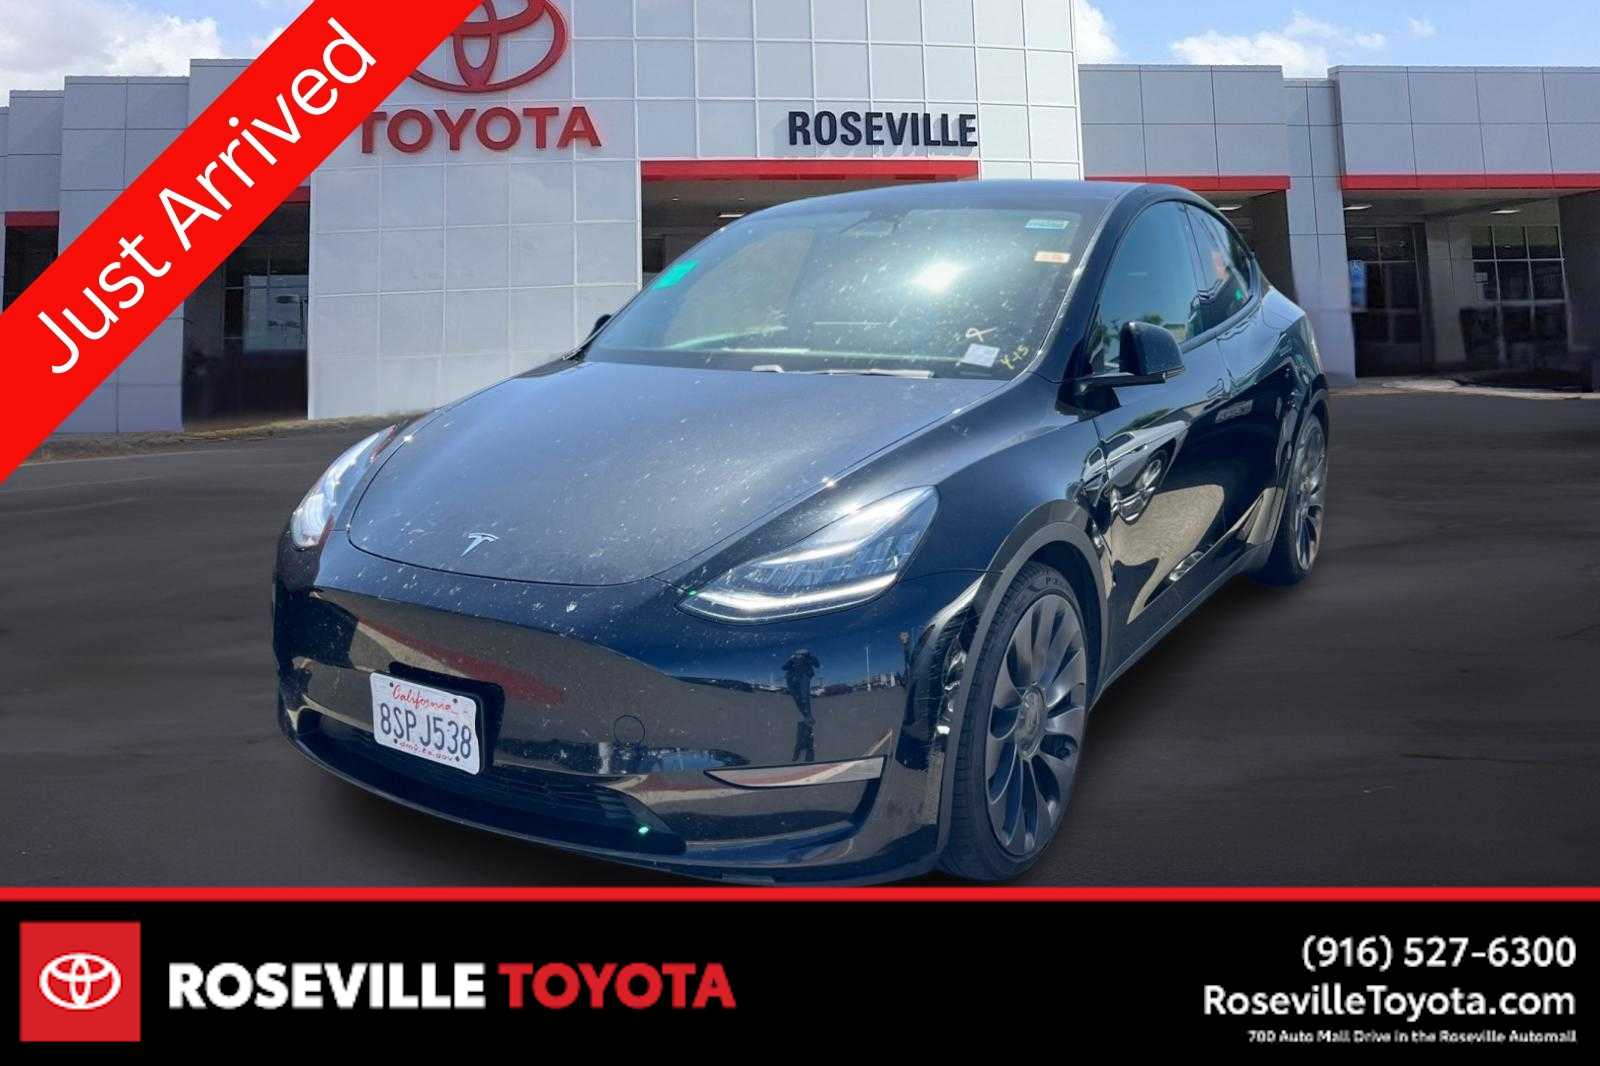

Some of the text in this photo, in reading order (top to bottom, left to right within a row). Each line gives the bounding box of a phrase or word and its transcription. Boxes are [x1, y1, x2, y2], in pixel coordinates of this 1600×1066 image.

[360, 106, 602, 154] TOYOTA
[788, 111, 978, 147] ROSEVILLE
[392, 684, 453, 710] California
[380, 702, 472, 760] 8SPJ538
